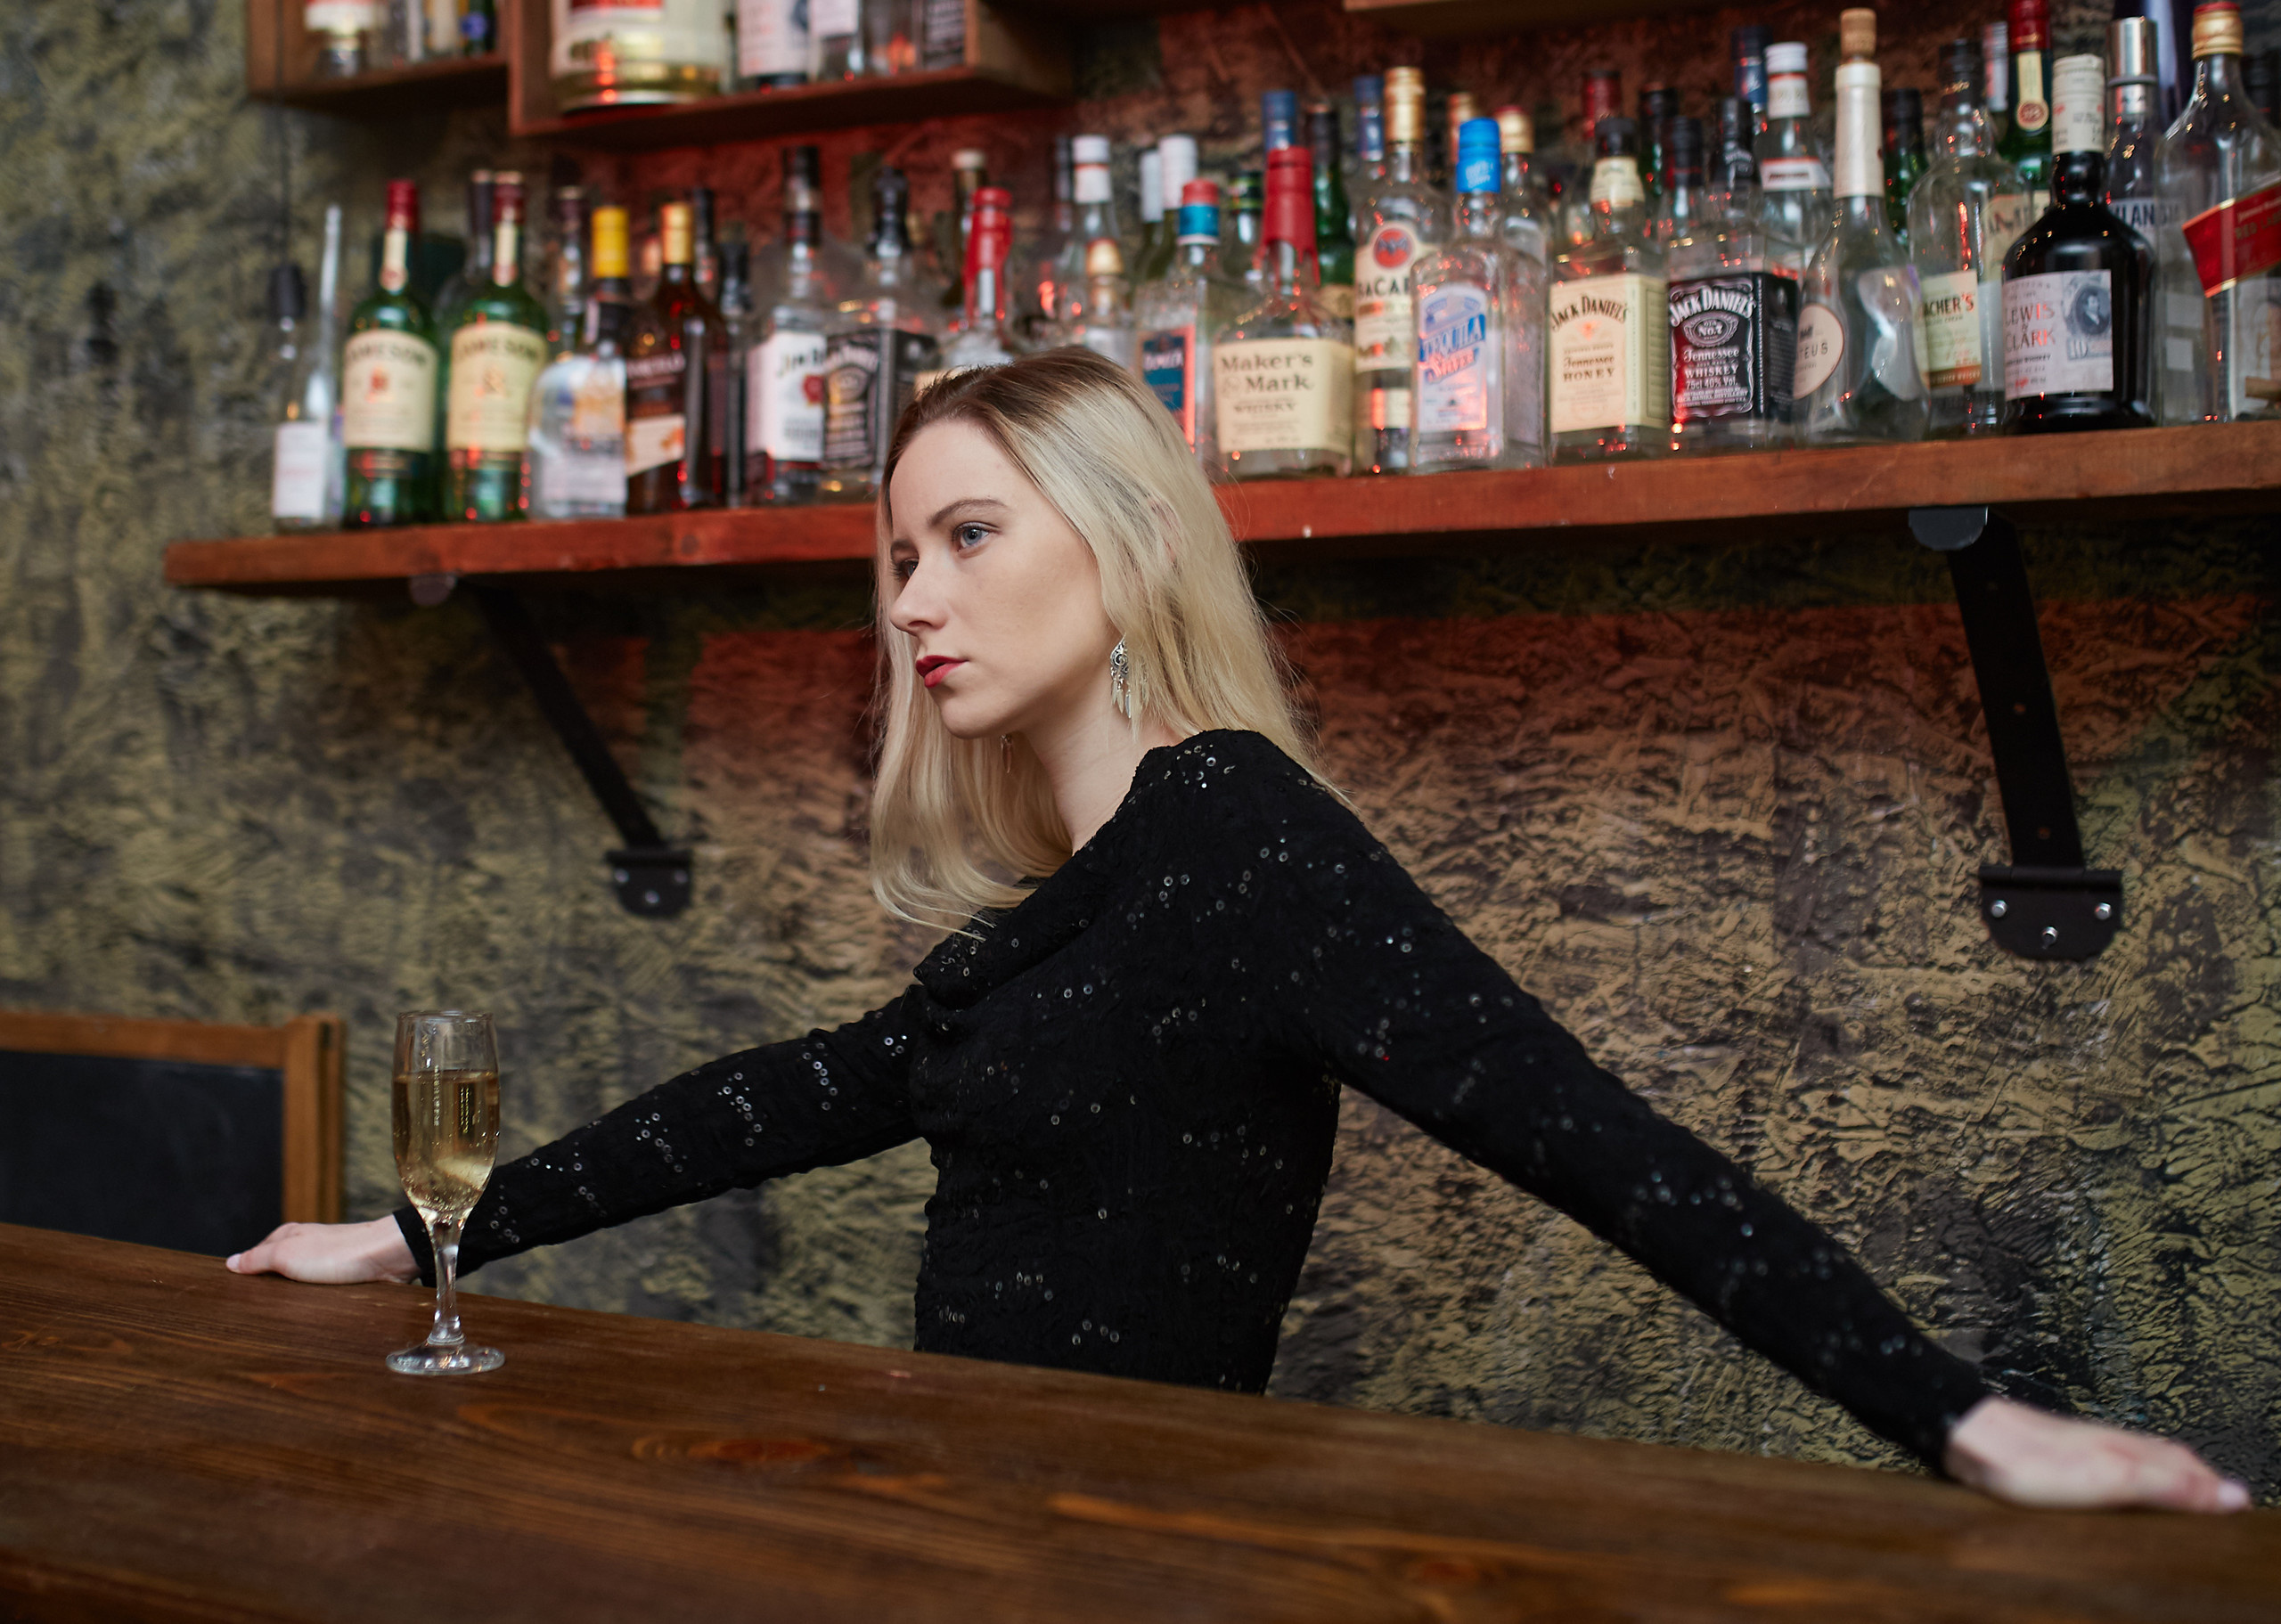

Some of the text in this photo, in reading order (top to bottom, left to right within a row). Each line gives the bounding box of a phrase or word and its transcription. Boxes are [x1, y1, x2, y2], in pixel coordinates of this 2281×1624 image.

[1551, 295, 1629, 332] JACK DANIEL'S
[1669, 284, 1756, 327] JACK DANIEL'S
[2005, 303, 2055, 327] LEWIS
[1423, 314, 1484, 358] TEQUILA
[2006, 327, 2056, 352] CLARK
[1683, 347, 1739, 363] Tennessee
[1798, 342, 1828, 360] TEUS
[1221, 353, 1314, 372] Maker's
[1564, 355, 1615, 369] Tennessee
[1684, 363, 1739, 379] WHISKEY
[1564, 367, 1615, 382] HONEY
[1686, 379, 1703, 390] 75cl
[1704, 376, 1721, 388] 40%
